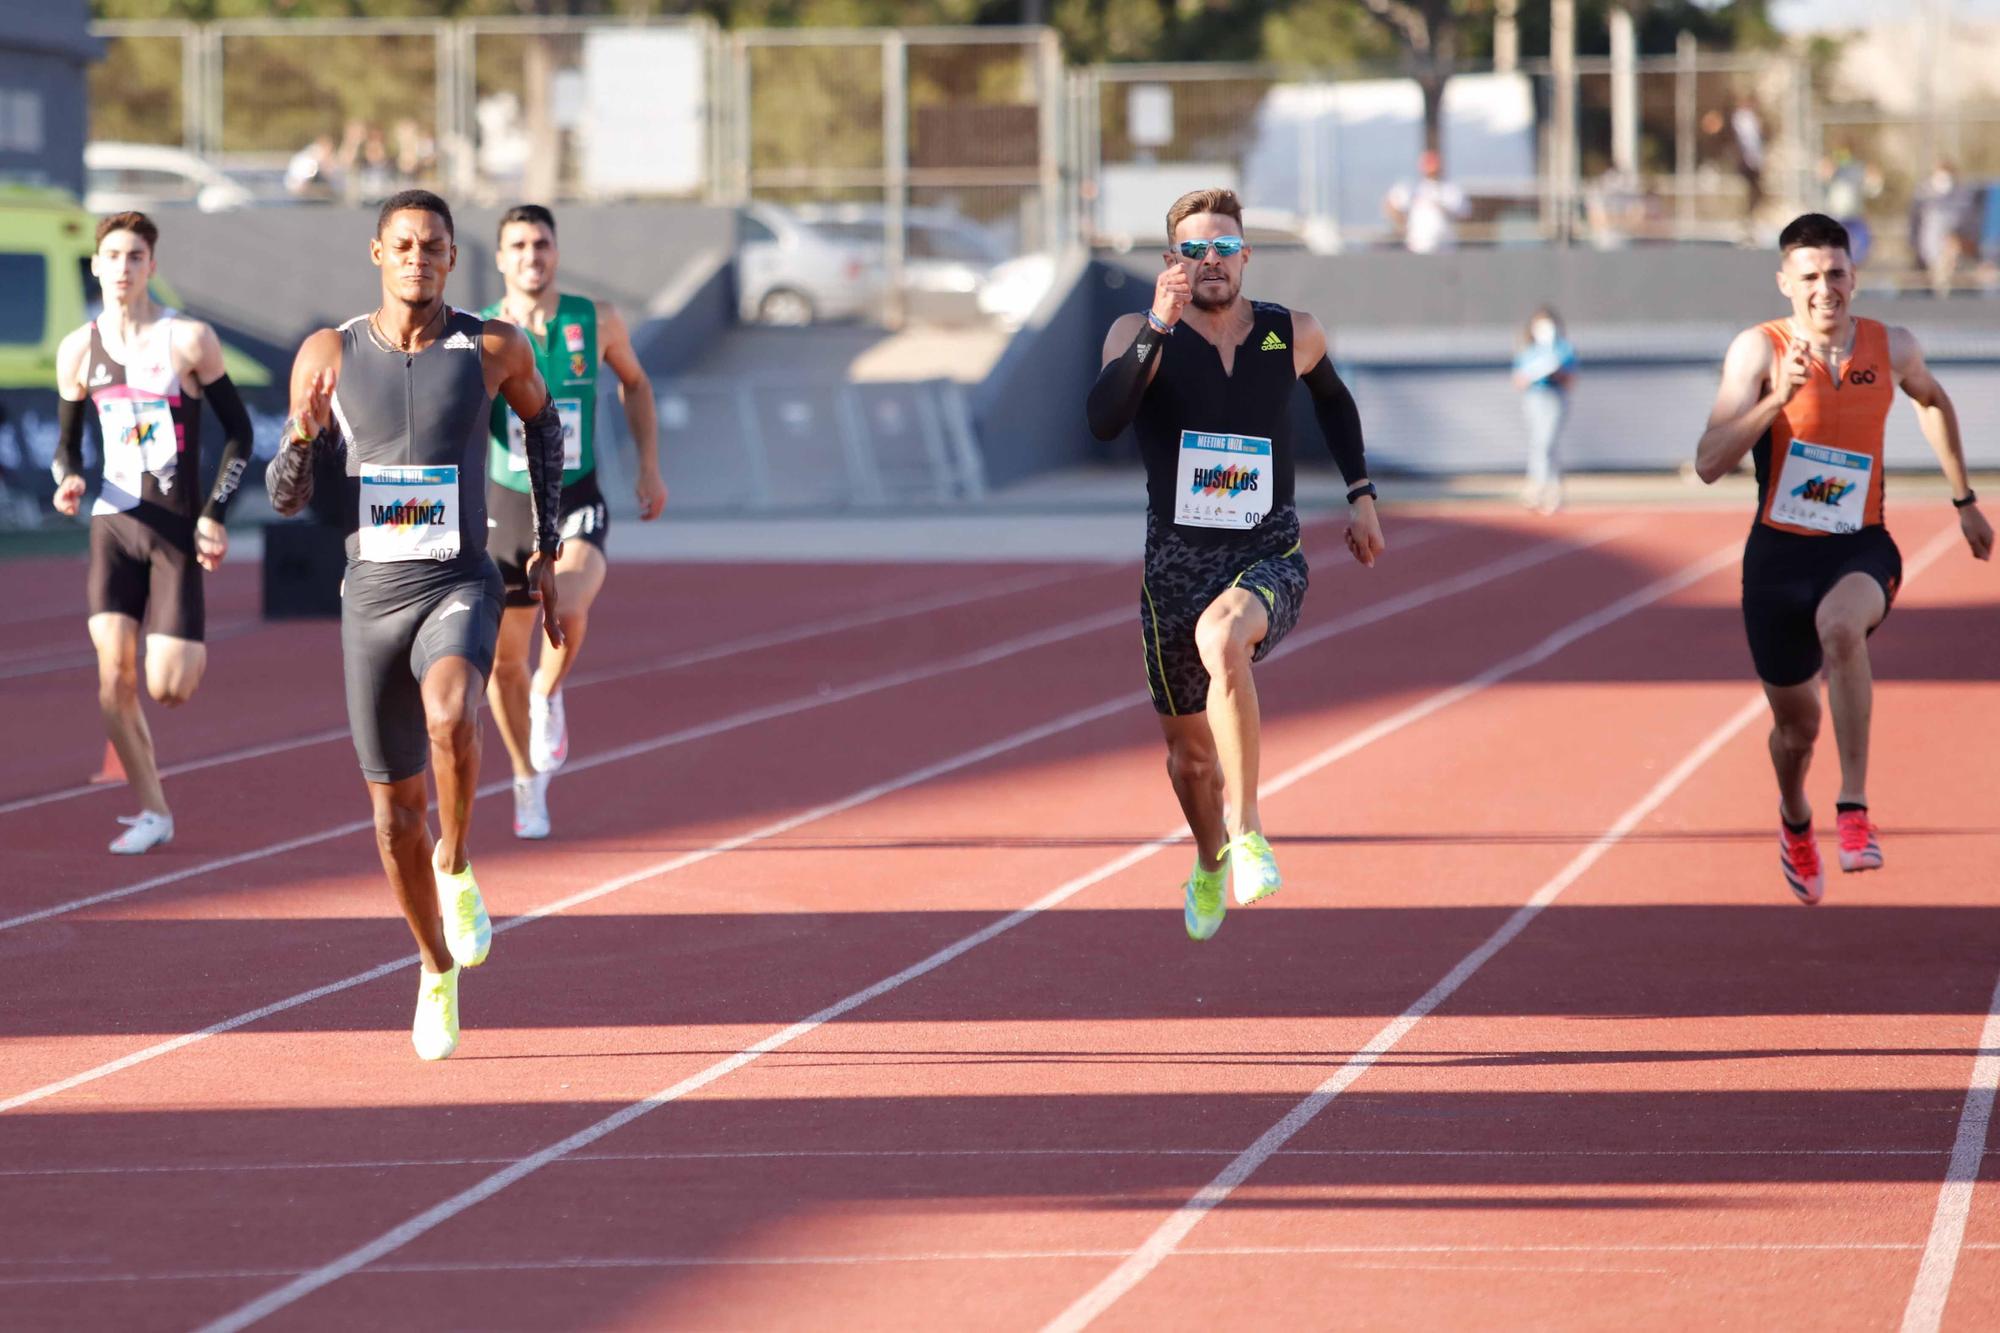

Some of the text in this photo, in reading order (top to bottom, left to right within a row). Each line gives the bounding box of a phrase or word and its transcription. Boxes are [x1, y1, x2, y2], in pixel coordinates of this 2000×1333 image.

[1261, 343, 1287, 351] adidas
[1197, 434, 1226, 449] MEETING
[1193, 467, 1258, 491] HUSILLOS
[370, 504, 446, 526] MARTINEZ
[1245, 511, 1266, 525] 00
[430, 547, 454, 560] 007
